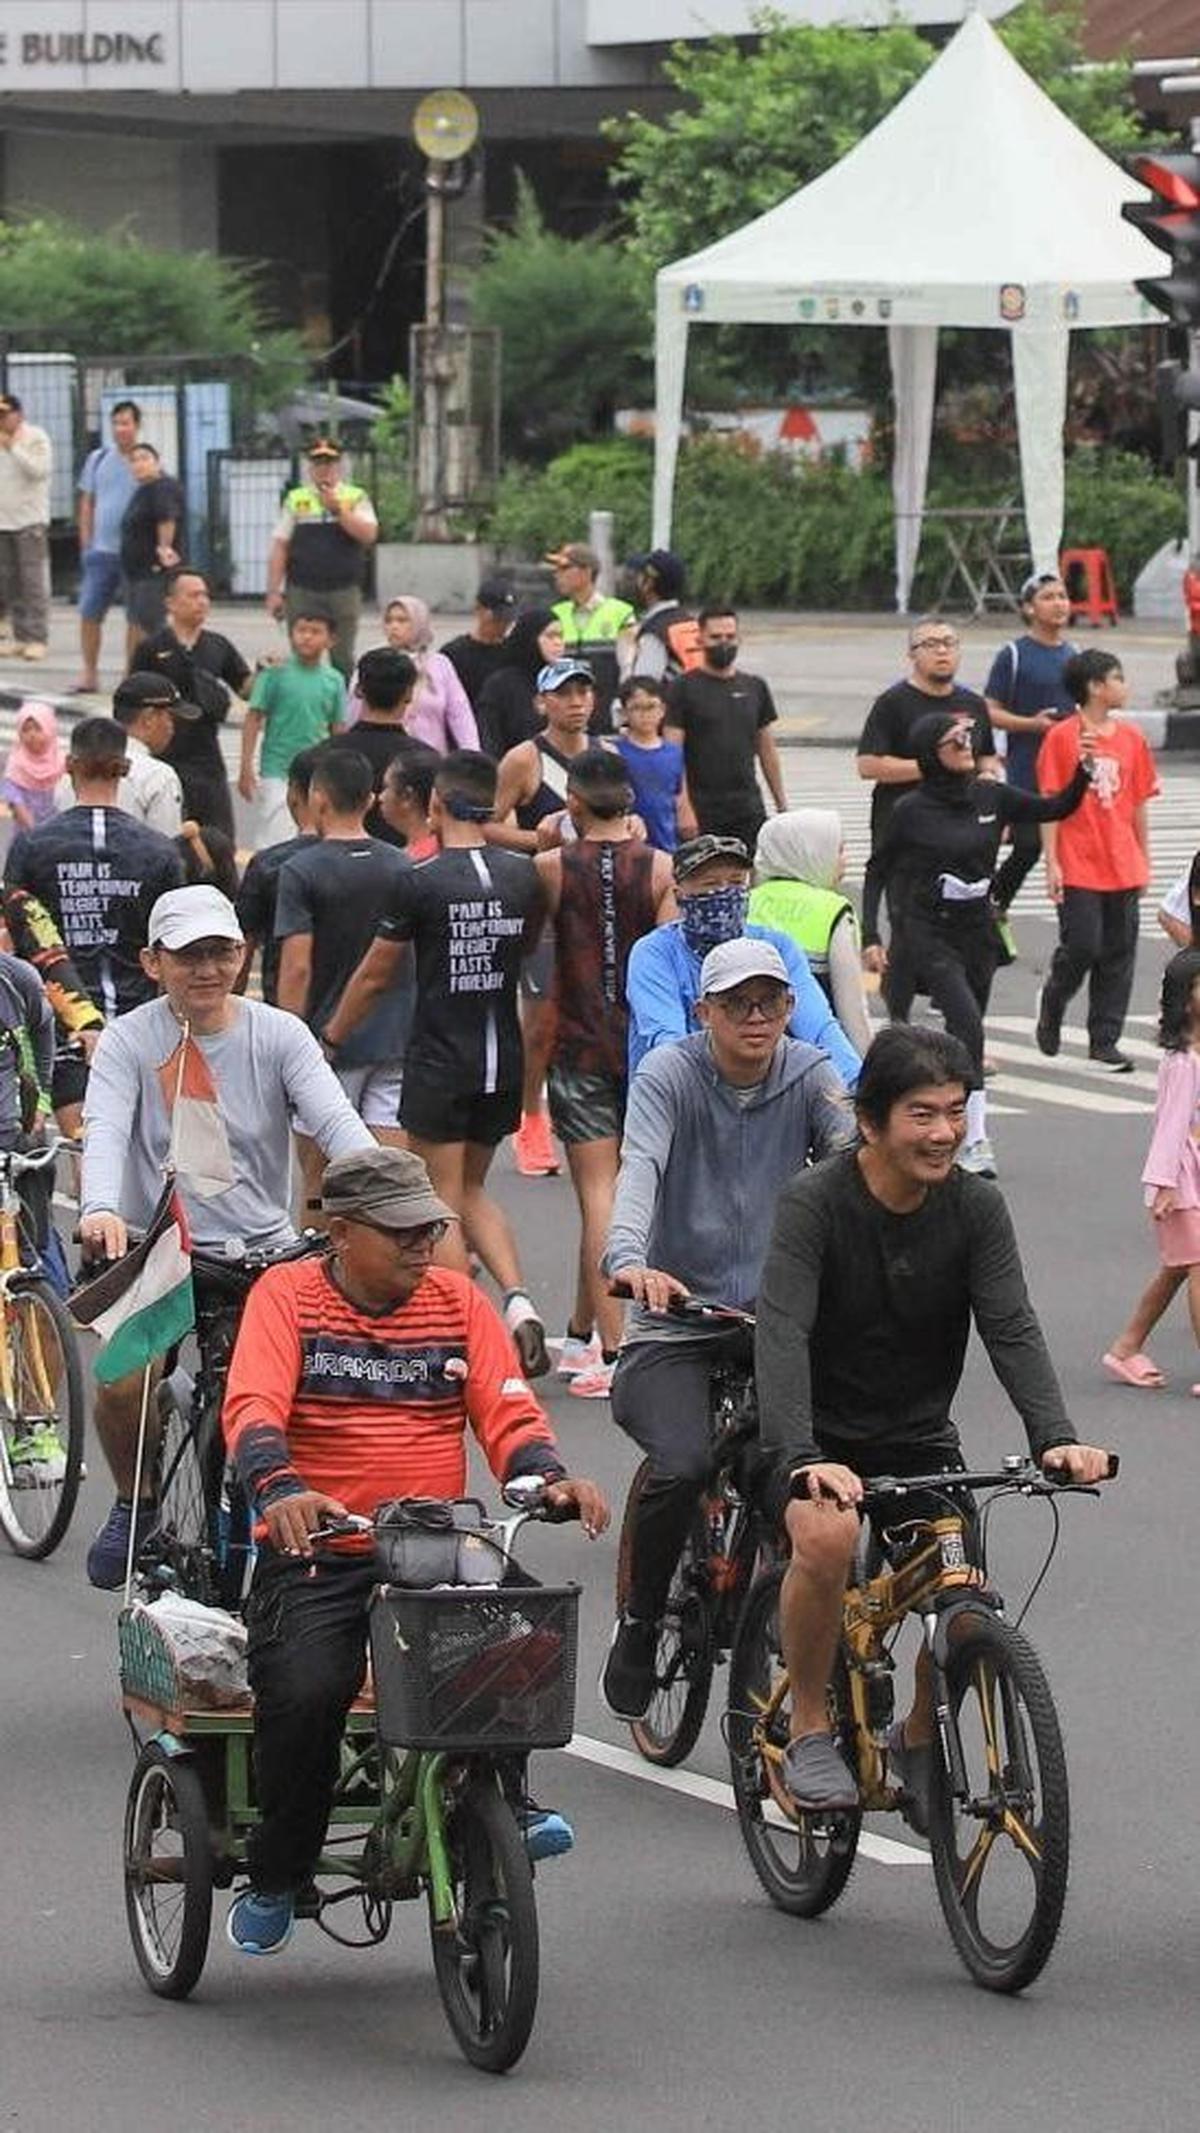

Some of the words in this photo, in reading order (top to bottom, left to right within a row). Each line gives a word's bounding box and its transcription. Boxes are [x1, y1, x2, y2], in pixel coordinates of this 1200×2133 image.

[22, 33, 165, 64] BUILDING
[57, 862, 93, 879] PAIN
[98, 862, 112, 879] IS
[449, 902, 485, 920] PAIN
[488, 901, 502, 917] IS
[63, 913, 104, 929] LASTS
[450, 956, 492, 974] LASTS
